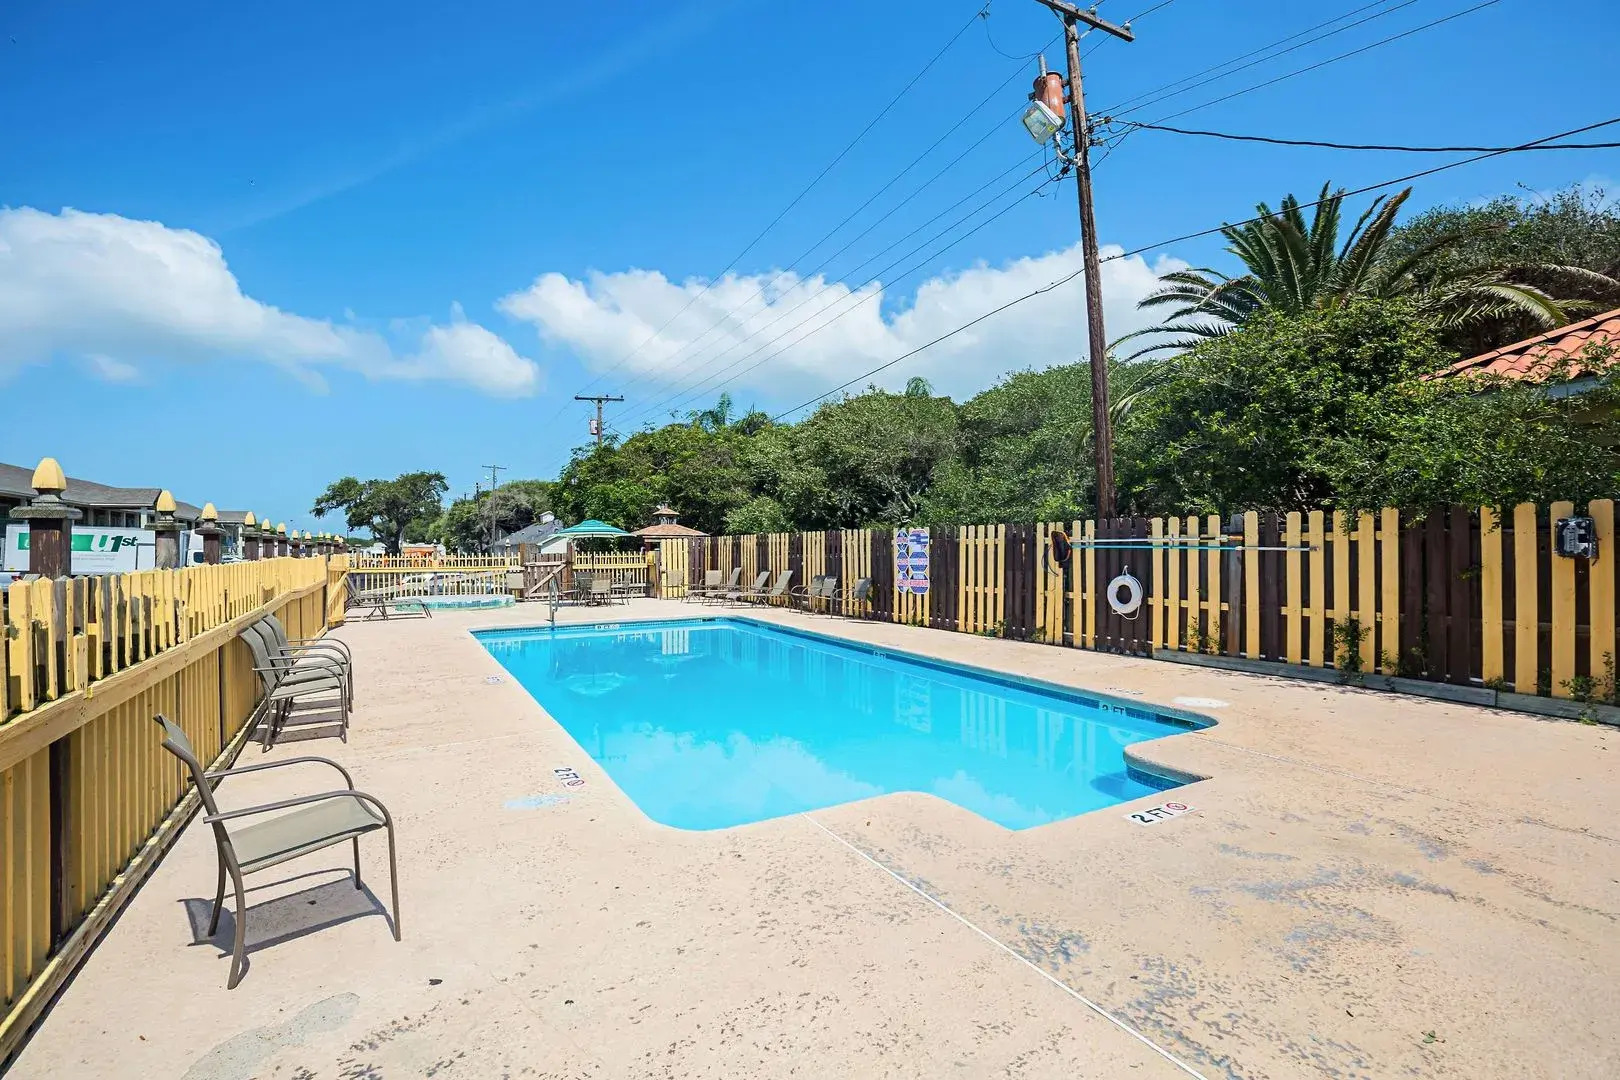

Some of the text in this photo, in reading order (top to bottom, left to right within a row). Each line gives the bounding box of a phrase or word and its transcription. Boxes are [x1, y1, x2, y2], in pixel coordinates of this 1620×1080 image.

[558, 772, 580, 780] FT
[1131, 807, 1174, 823] 2 FT
